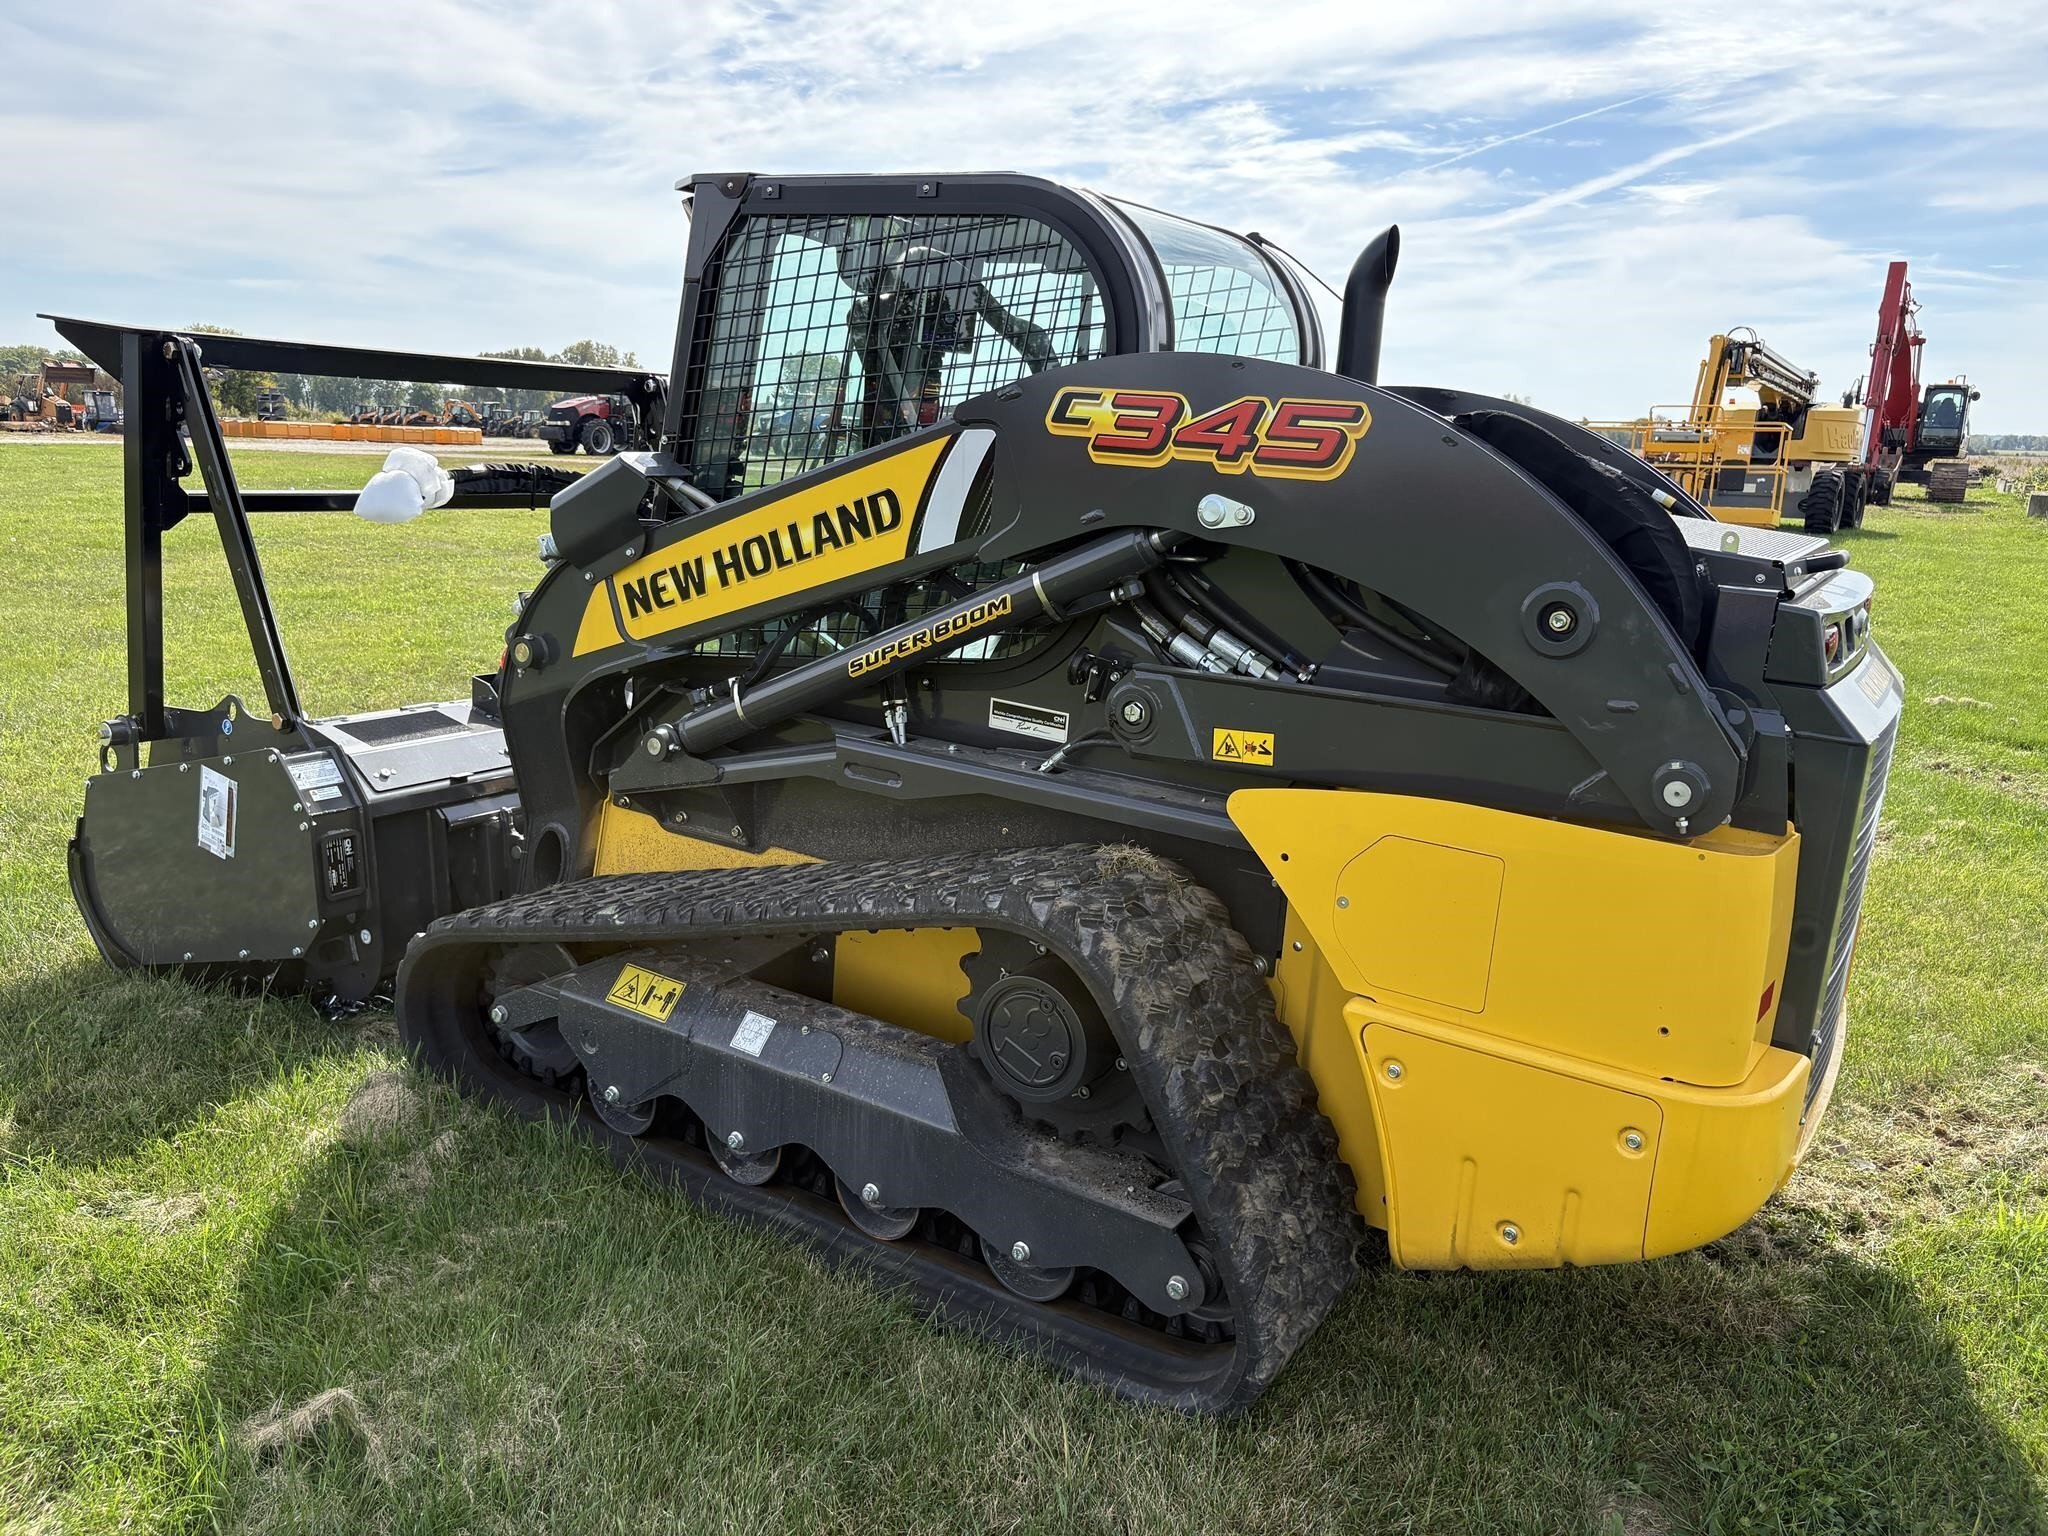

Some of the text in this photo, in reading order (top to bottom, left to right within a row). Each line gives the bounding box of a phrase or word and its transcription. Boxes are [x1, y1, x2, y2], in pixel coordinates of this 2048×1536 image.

[1046, 387, 1371, 480] C345
[622, 488, 903, 619] NEW HOLLAND
[848, 593, 1012, 678] SUPER BOOM
[1006, 713, 1031, 721] Comprehensive
